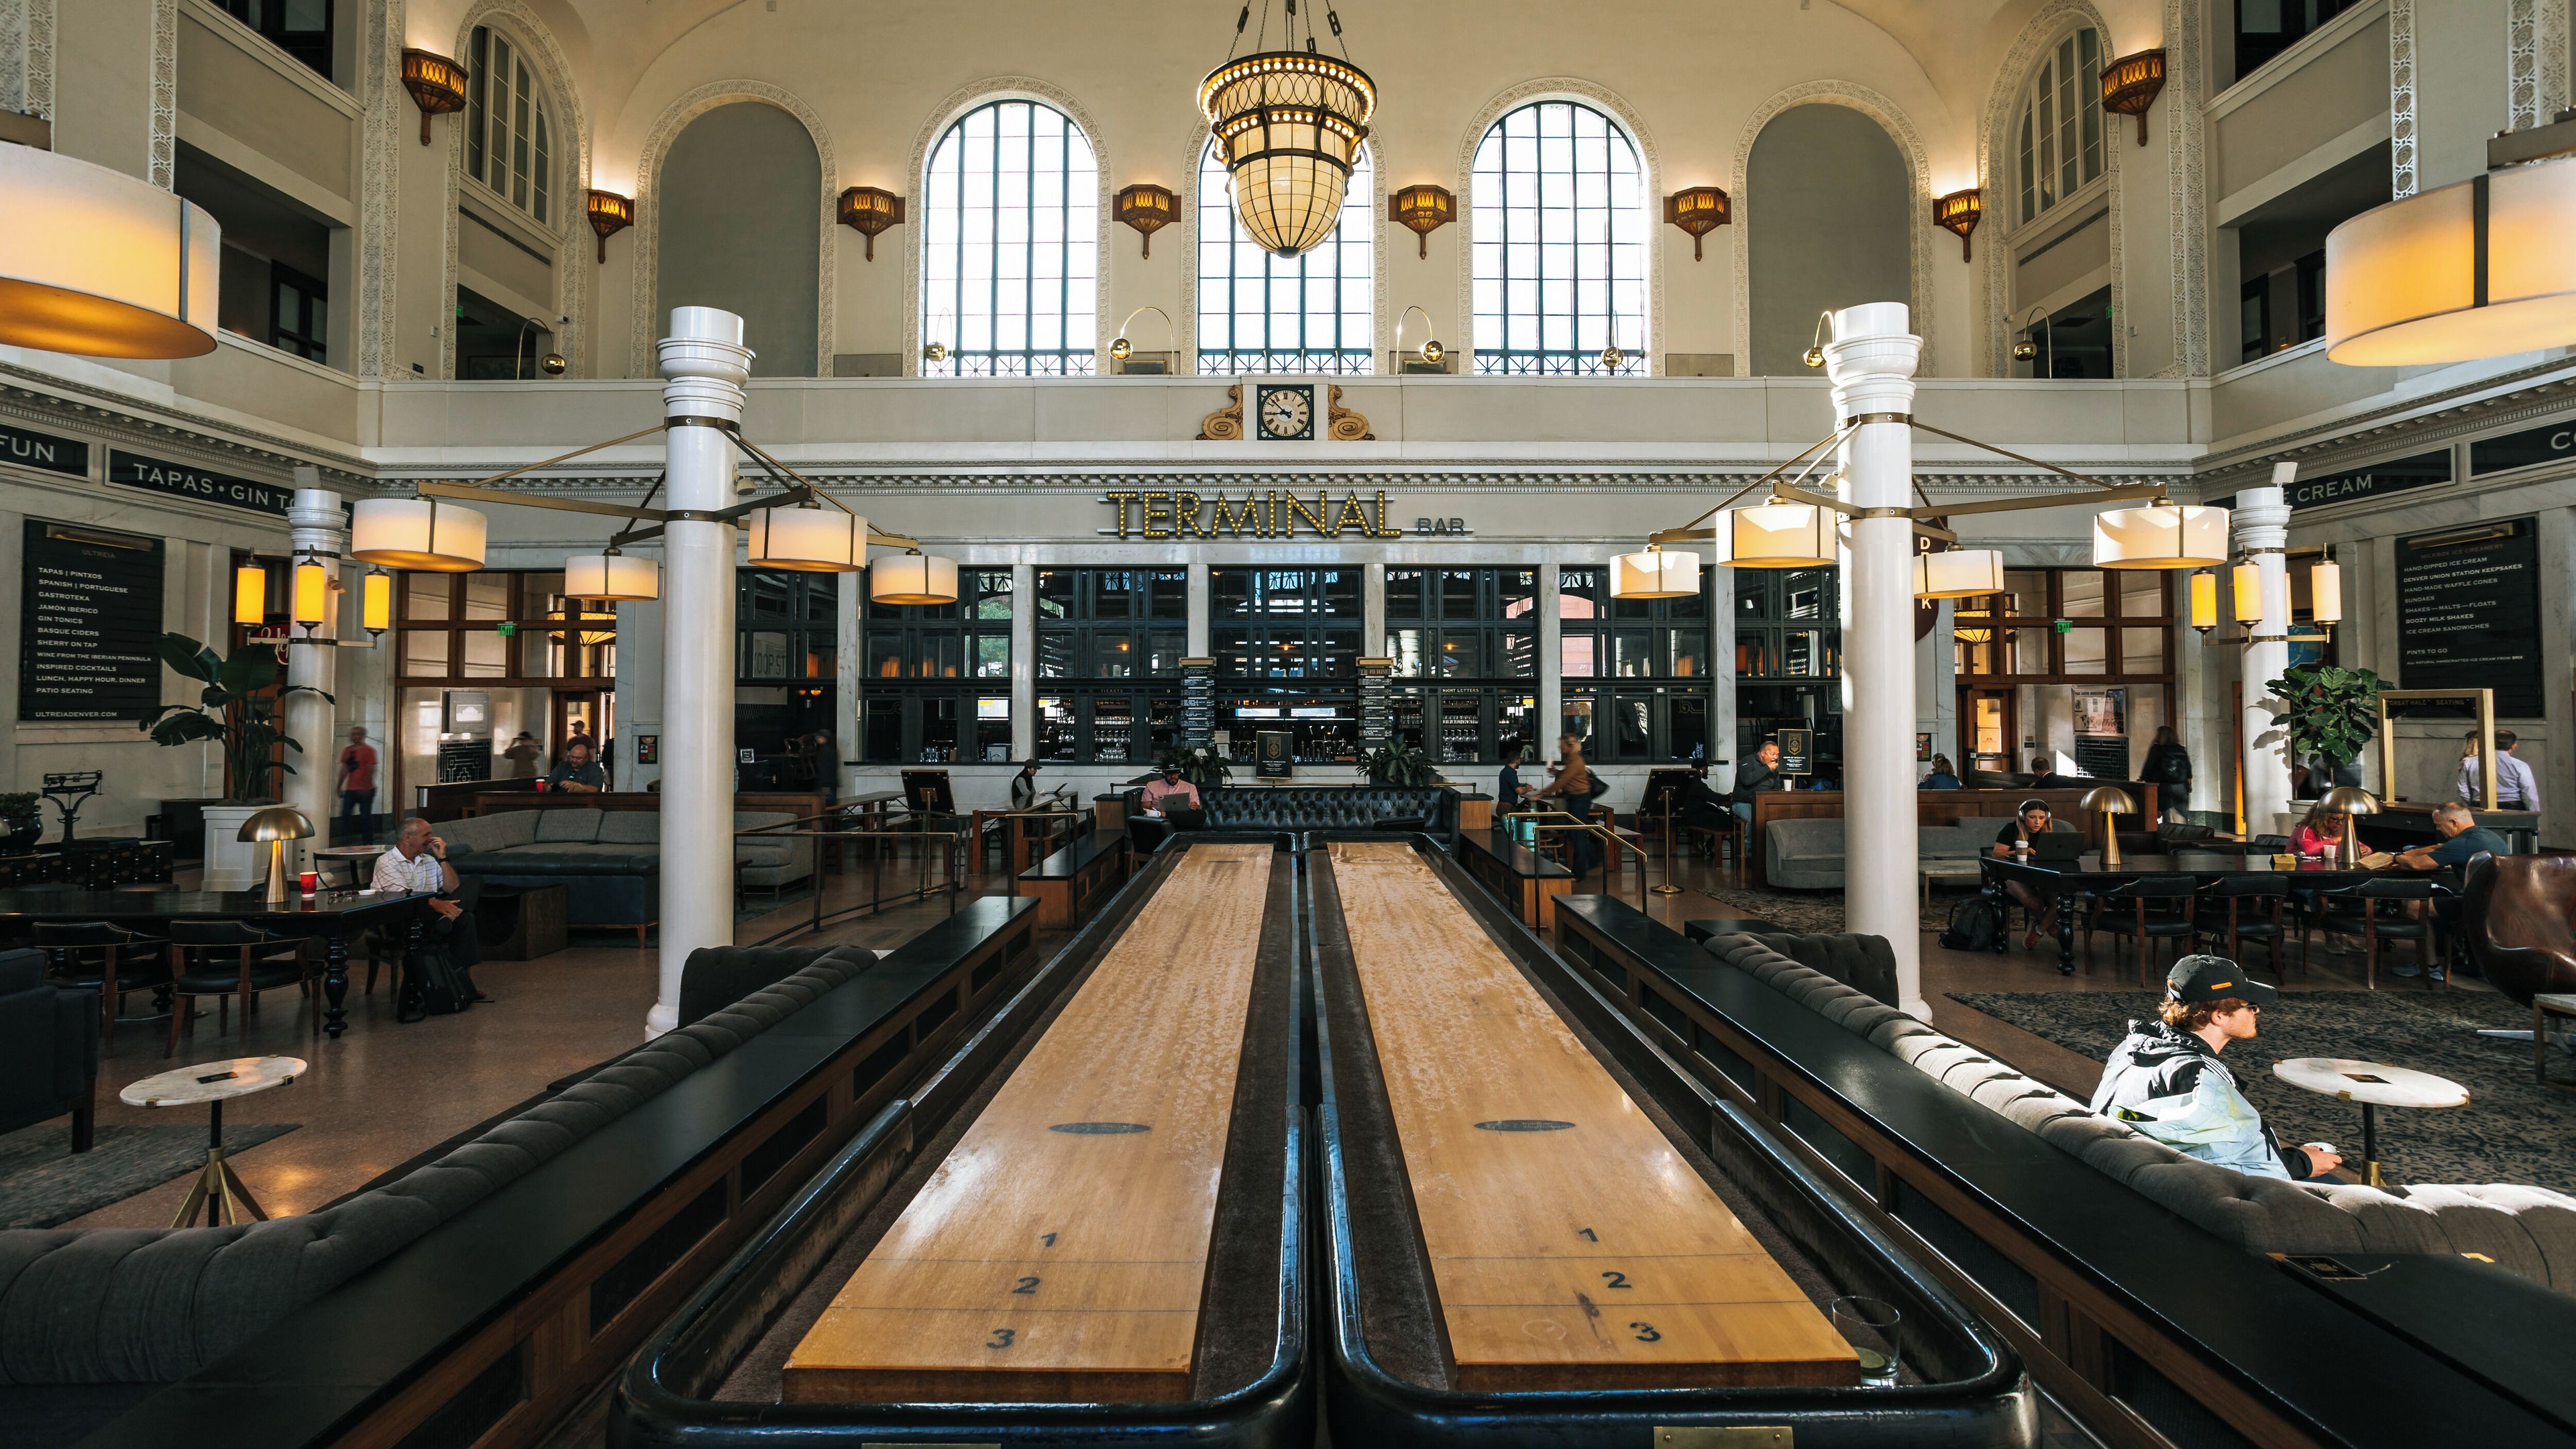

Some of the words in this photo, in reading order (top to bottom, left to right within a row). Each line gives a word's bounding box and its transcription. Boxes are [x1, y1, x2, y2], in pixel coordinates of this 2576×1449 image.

[133, 463, 213, 494] TAPAS
[231, 485, 268, 505] GIN
[2297, 474, 2373, 502] CREAM
[1106, 489, 1401, 538] TERMINAL
[1417, 517, 1466, 537] BAR
[82, 549, 115, 558] ULTREIA
[2404, 562, 2448, 572] HAND-DIPPED
[2463, 557, 2487, 565] CREAM
[38, 567, 63, 576] TAPAS
[70, 571, 102, 580] PINTXOS
[2404, 575, 2428, 583] DENVER
[2452, 569, 2480, 577] STATION
[2481, 564, 2523, 574] KEEPSAKES
[38, 579, 72, 588] SPANISH
[79, 583, 128, 594] PORTUGUESE
[2404, 584, 2443, 593] HAND-MADE
[2444, 580, 2471, 588] WAFFLE
[2473, 578, 2498, 586] CONES
[38, 592, 90, 602] GASTROTEKA
[2404, 596, 2435, 604] SUNDAES
[2057, 623, 2071, 633] EXIT
[2443, 623, 2490, 632] SANDWICHES
[37, 639, 69, 647] SHERRY
[1040, 1232, 1057, 1247] 1
[1578, 1227, 1599, 1243] 1
[1012, 1277, 1040, 1294] 2
[1602, 1272, 1631, 1289] 2
[986, 1328, 1015, 1349] 3
[1629, 1322, 1661, 1342] 3
